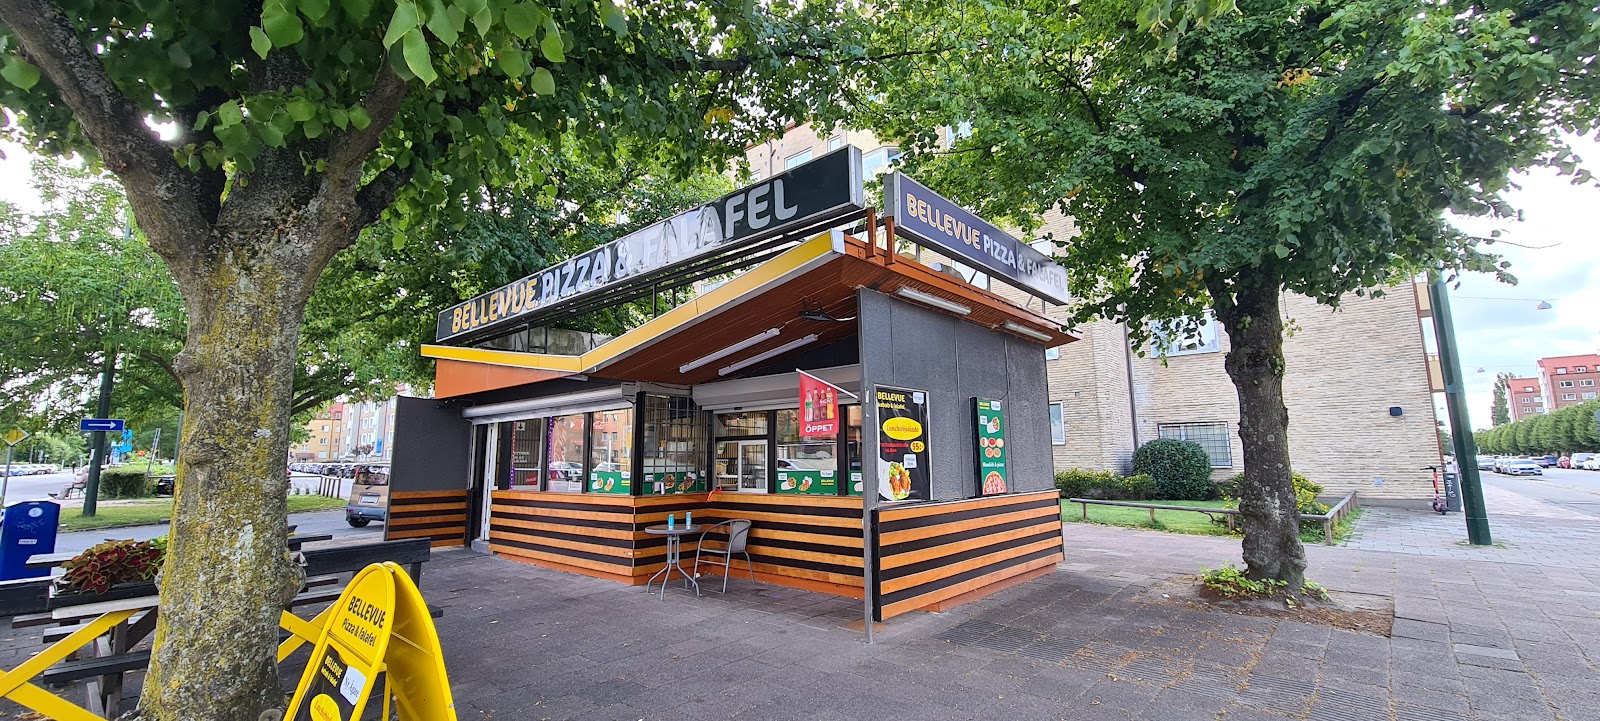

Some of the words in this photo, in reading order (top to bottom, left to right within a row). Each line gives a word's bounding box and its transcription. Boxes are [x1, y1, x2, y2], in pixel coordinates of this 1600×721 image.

[906, 193, 981, 250] BELLEVUE
[983, 234, 1017, 270] PIZZA
[1017, 253, 1026, 273] &
[1026, 258, 1065, 288] FALAFEL
[451, 279, 538, 334] BELLEVUE
[541, 247, 611, 302] PIZZA
[613, 241, 633, 279] &
[643, 179, 798, 266] FALAFEL
[877, 391, 905, 402] BELLEVUE
[805, 423, 834, 433] ÖPPET
[347, 596, 386, 629] BELLEVUE
[341, 618, 356, 634] Pizza
[354, 625, 360, 637] &
[324, 655, 343, 678] BELLEVUE
